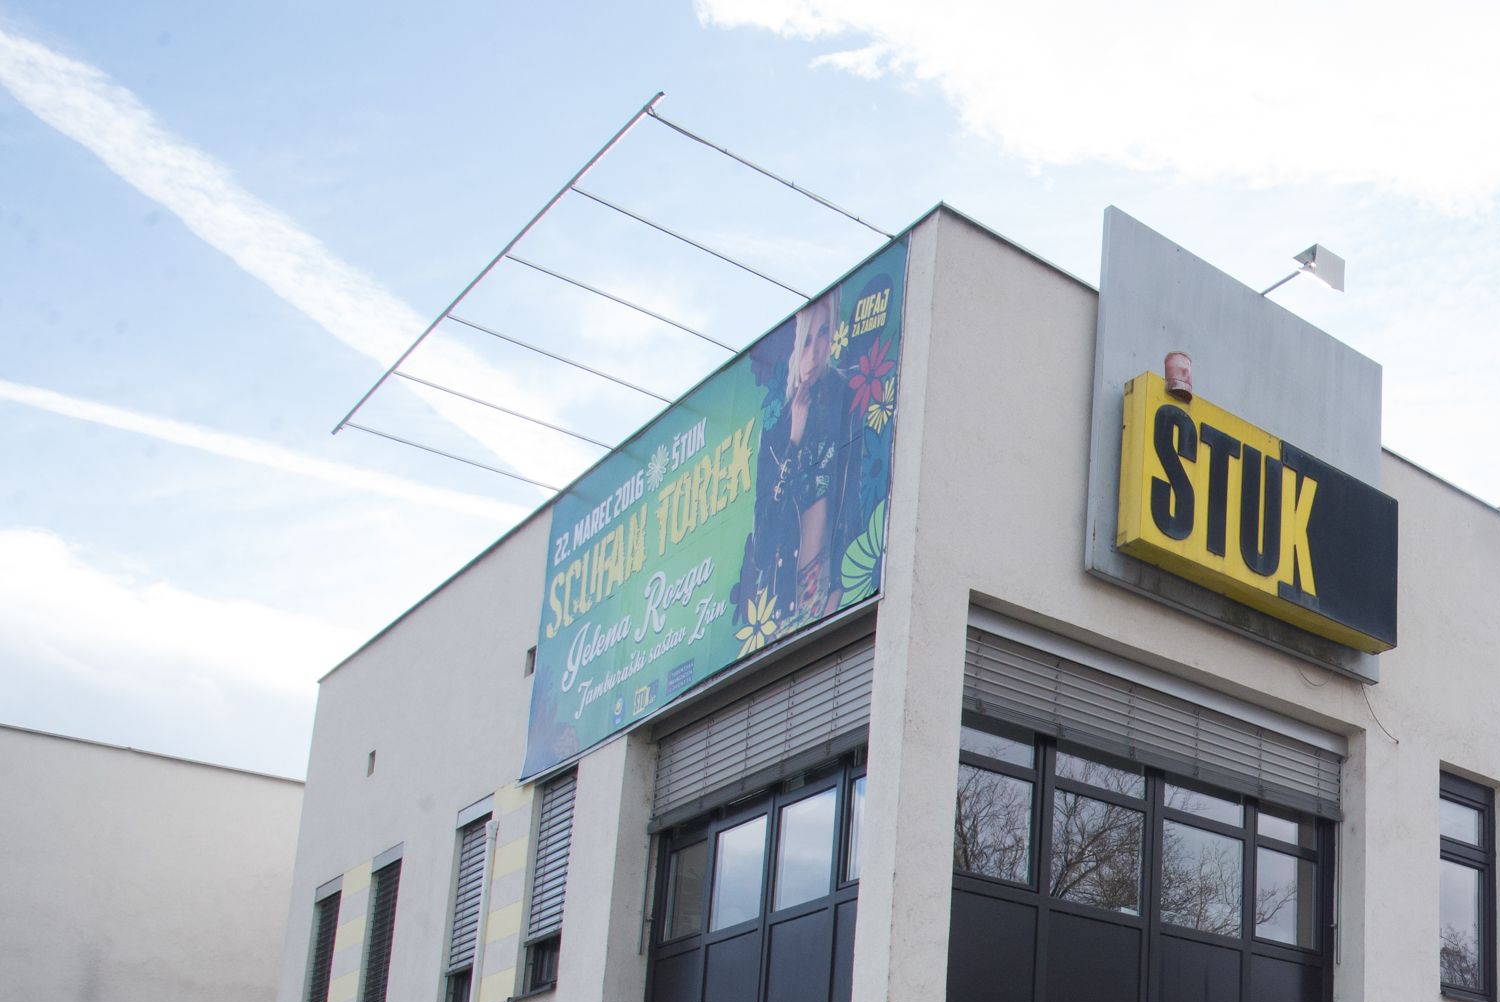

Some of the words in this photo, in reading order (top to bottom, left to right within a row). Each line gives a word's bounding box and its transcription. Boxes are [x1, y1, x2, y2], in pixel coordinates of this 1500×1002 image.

[851, 323, 860, 338] ZA
[860, 312, 886, 335] ZABAVO
[855, 288, 890, 323] CUFAJ
[546, 502, 648, 639] SCUFAN
[655, 417, 755, 557] TOREK
[554, 532, 571, 567] 22.
[573, 495, 613, 551] MAREC
[614, 469, 644, 518] 2016
[671, 417, 707, 472] ŠTUK
[561, 615, 631, 692] Jelena
[634, 556, 714, 643] Rozga
[574, 651, 647, 719] Tamburaški
[648, 627, 687, 663] sastav
[688, 593, 727, 645] Zrin
